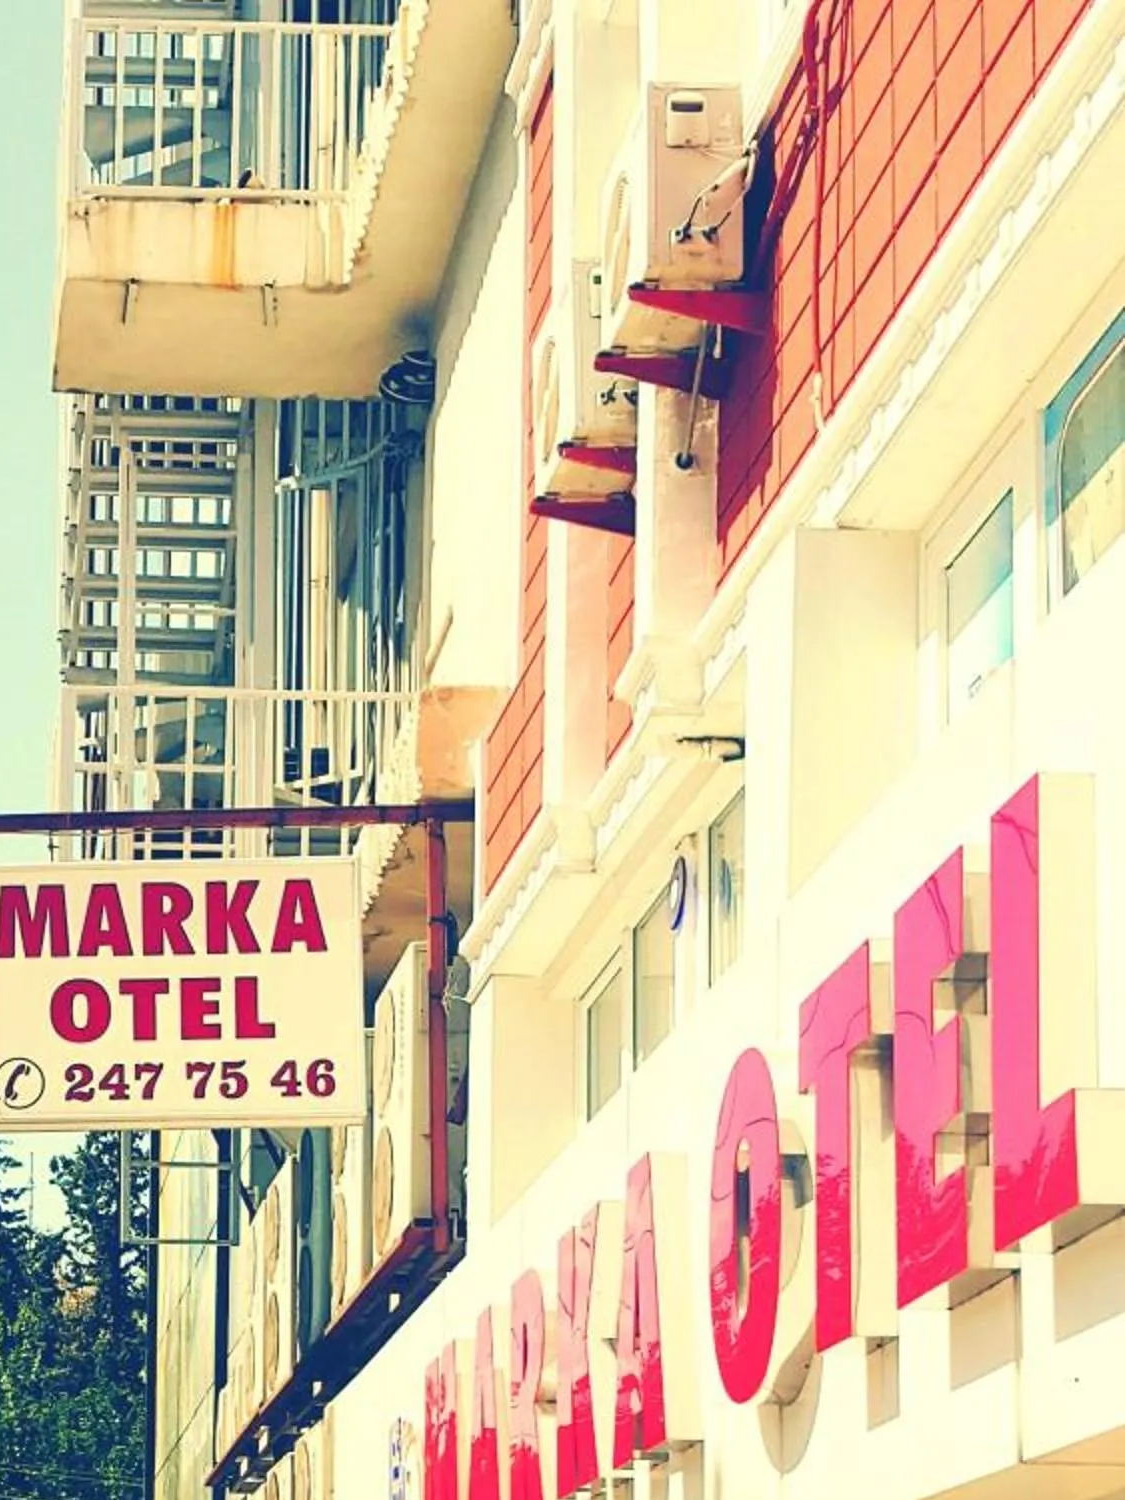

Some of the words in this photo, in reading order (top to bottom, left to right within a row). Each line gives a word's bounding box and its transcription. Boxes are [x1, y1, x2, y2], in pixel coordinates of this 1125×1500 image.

[49, 976, 276, 1044] OTEL
[64, 1062, 164, 1102] 247
[185, 1060, 250, 1099] 75
[270, 1058, 336, 1098] 46
[709, 772, 1080, 1405] OTEL
